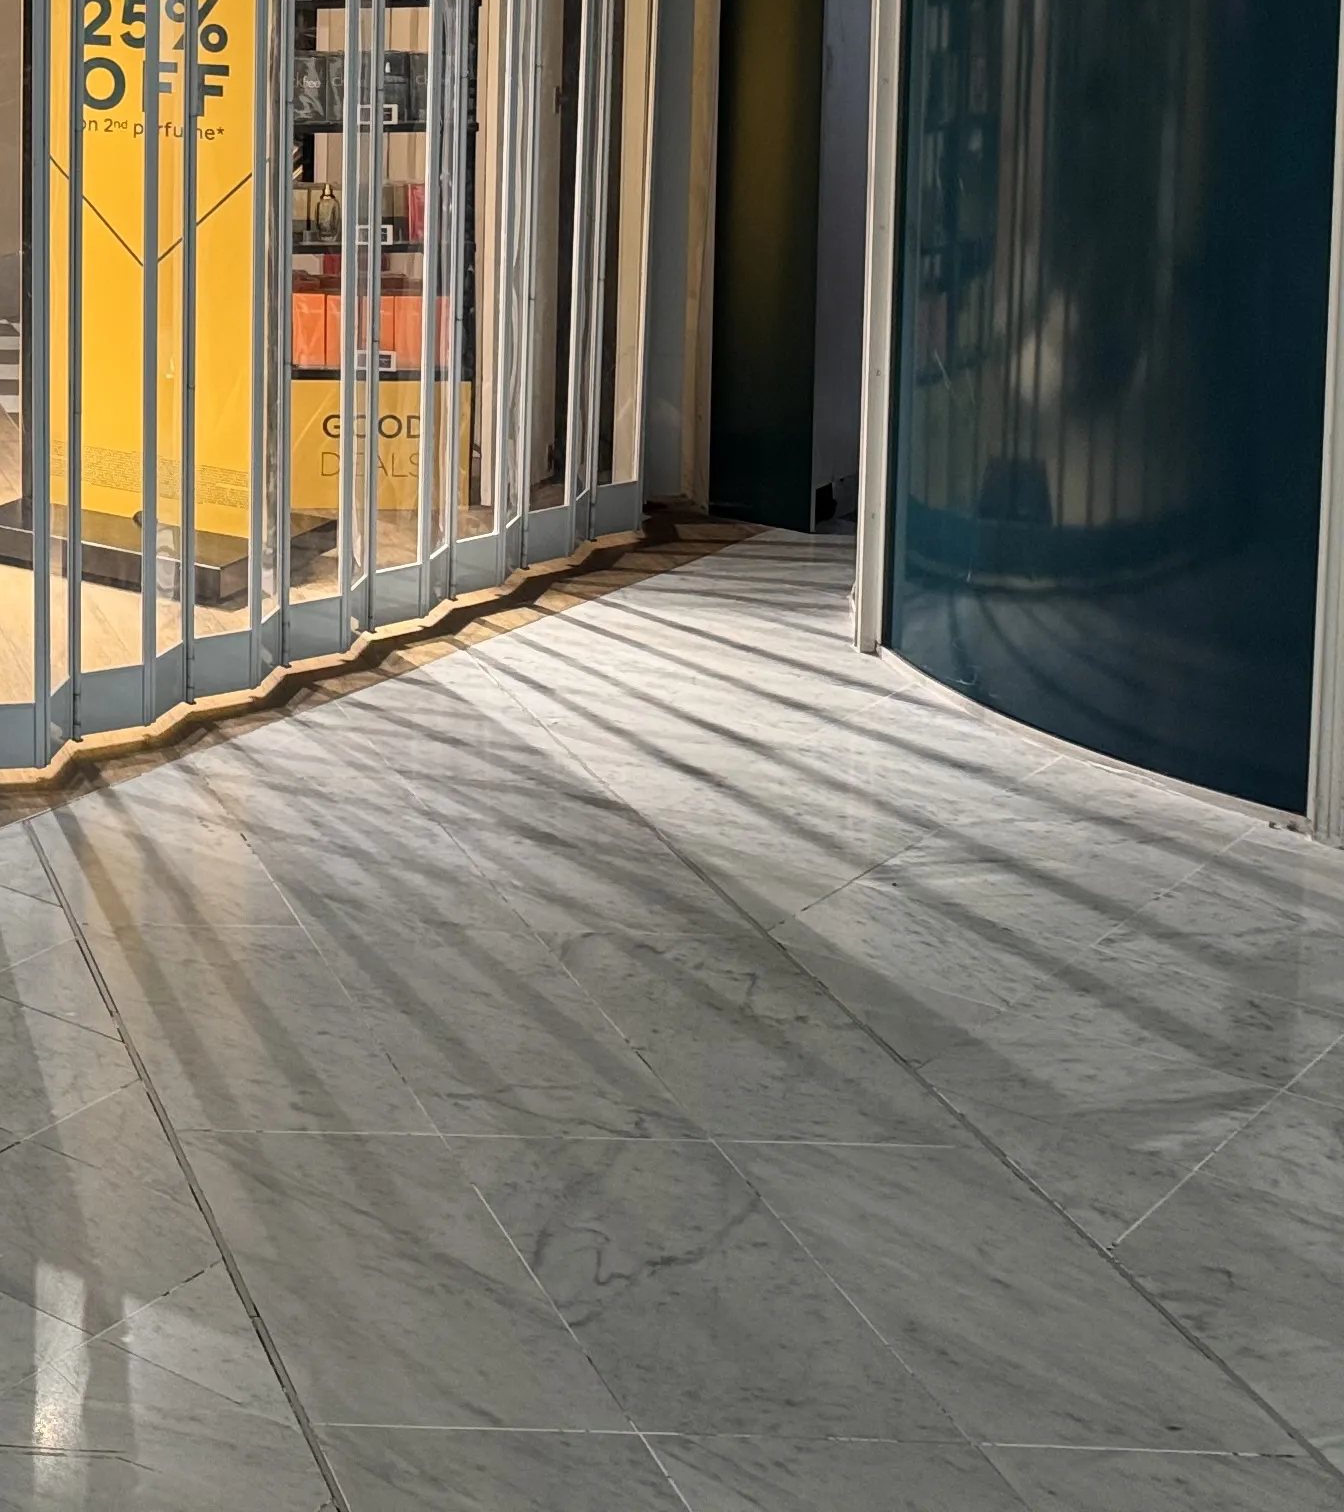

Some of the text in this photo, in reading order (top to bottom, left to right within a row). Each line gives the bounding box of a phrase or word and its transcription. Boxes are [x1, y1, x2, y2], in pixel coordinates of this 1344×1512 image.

[83, 56, 230, 118] OFF
[103, 118, 128, 133] 2nd
[133, 121, 225, 141] prfue
